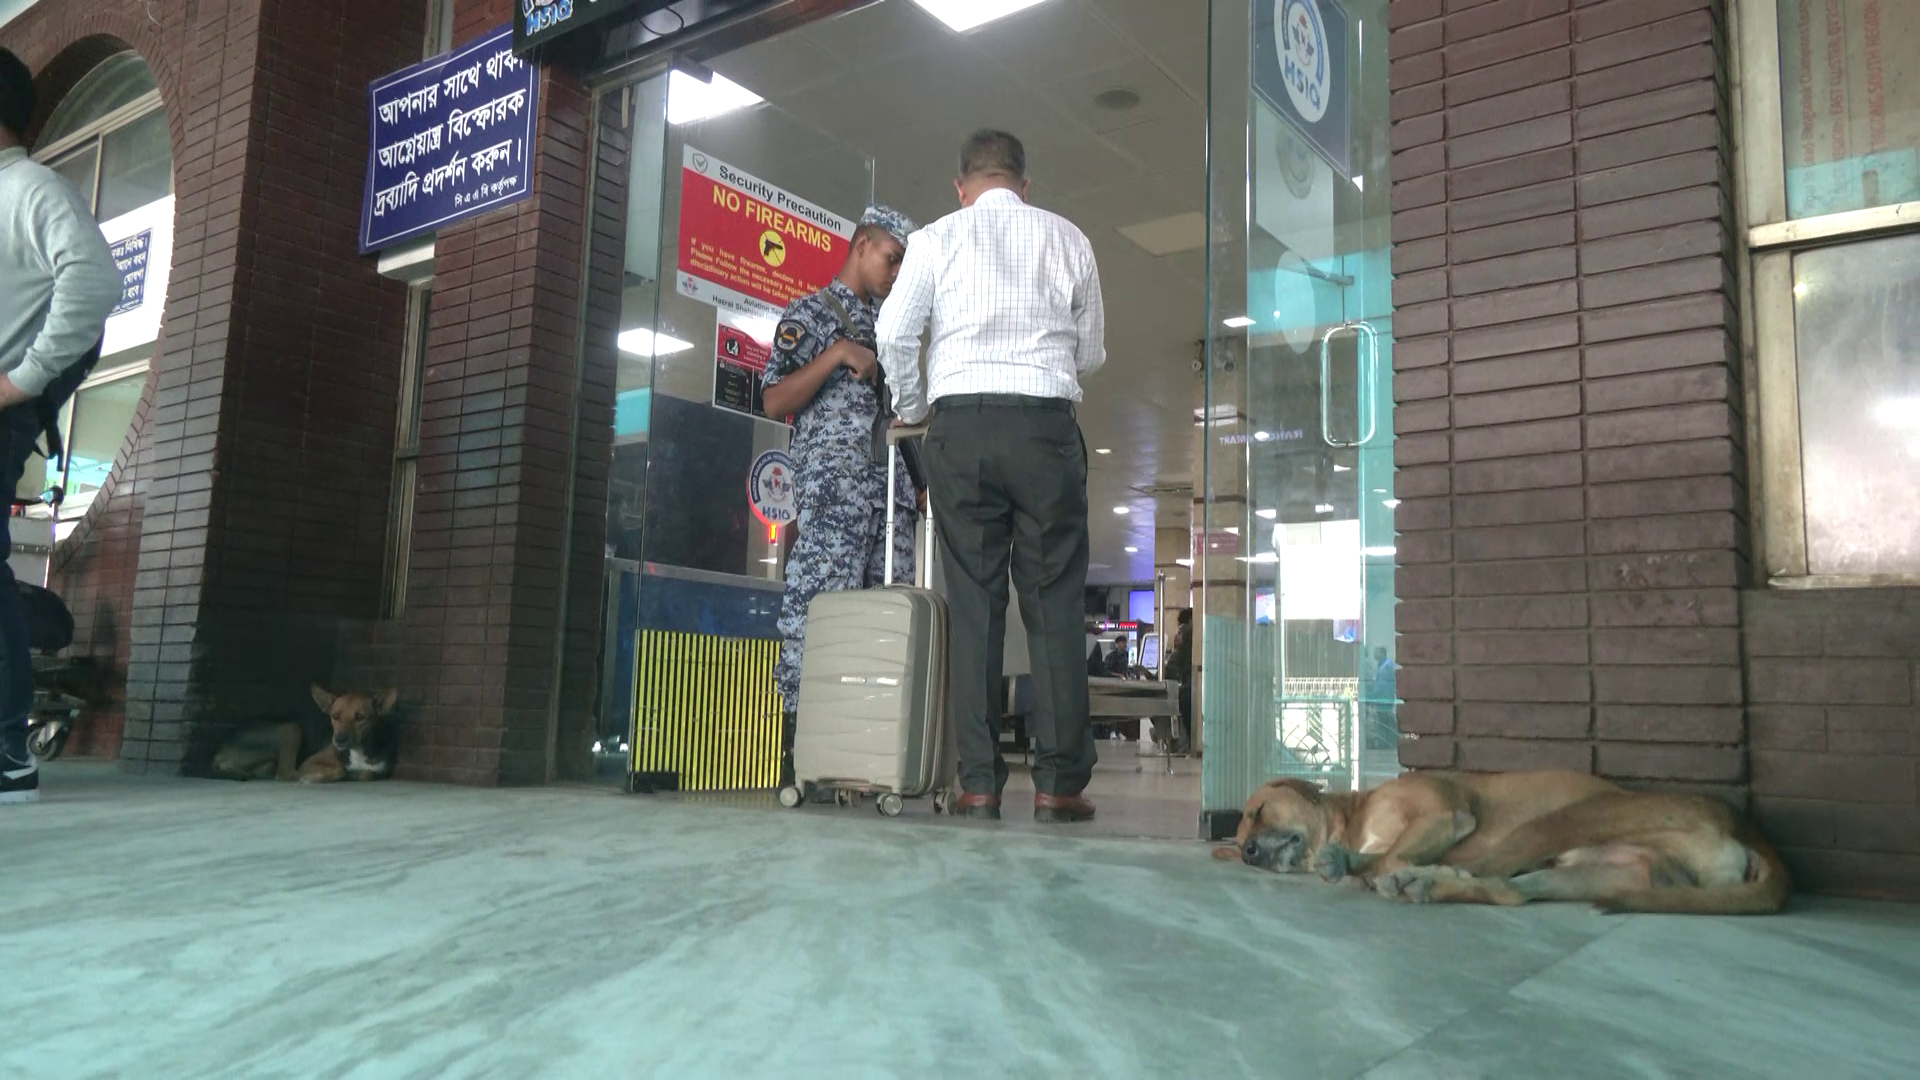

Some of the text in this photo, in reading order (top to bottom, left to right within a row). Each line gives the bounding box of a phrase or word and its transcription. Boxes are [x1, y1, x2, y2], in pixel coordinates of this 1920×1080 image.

[378, 83, 440, 126] আপনার
[443, 61, 482, 99] সাথে
[448, 88, 527, 143] বিস্ফোরক
[374, 171, 421, 217] দ্রব্যাদি
[422, 152, 467, 195] প্রদর্শন
[719, 164, 842, 232] Security Precaution
[713, 184, 832, 253] NO FIREARMS
[701, 242, 714, 253] you
[720, 248, 735, 261] have
